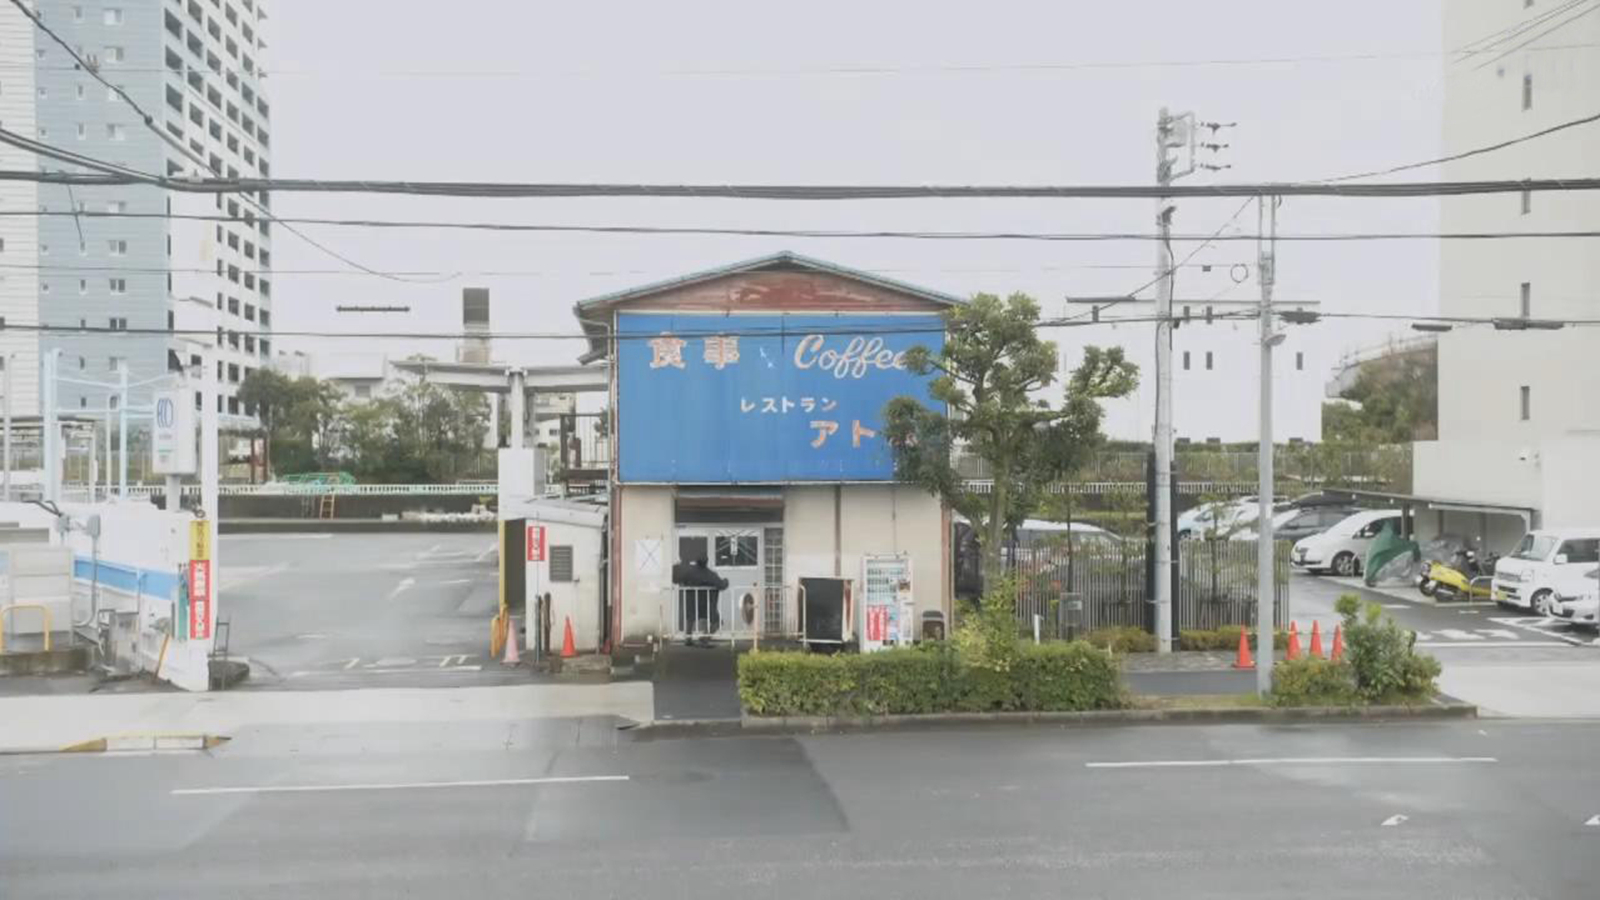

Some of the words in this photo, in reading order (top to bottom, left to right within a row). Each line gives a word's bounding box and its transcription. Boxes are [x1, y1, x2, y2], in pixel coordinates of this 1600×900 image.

[740, 396, 837, 413] レストラン
